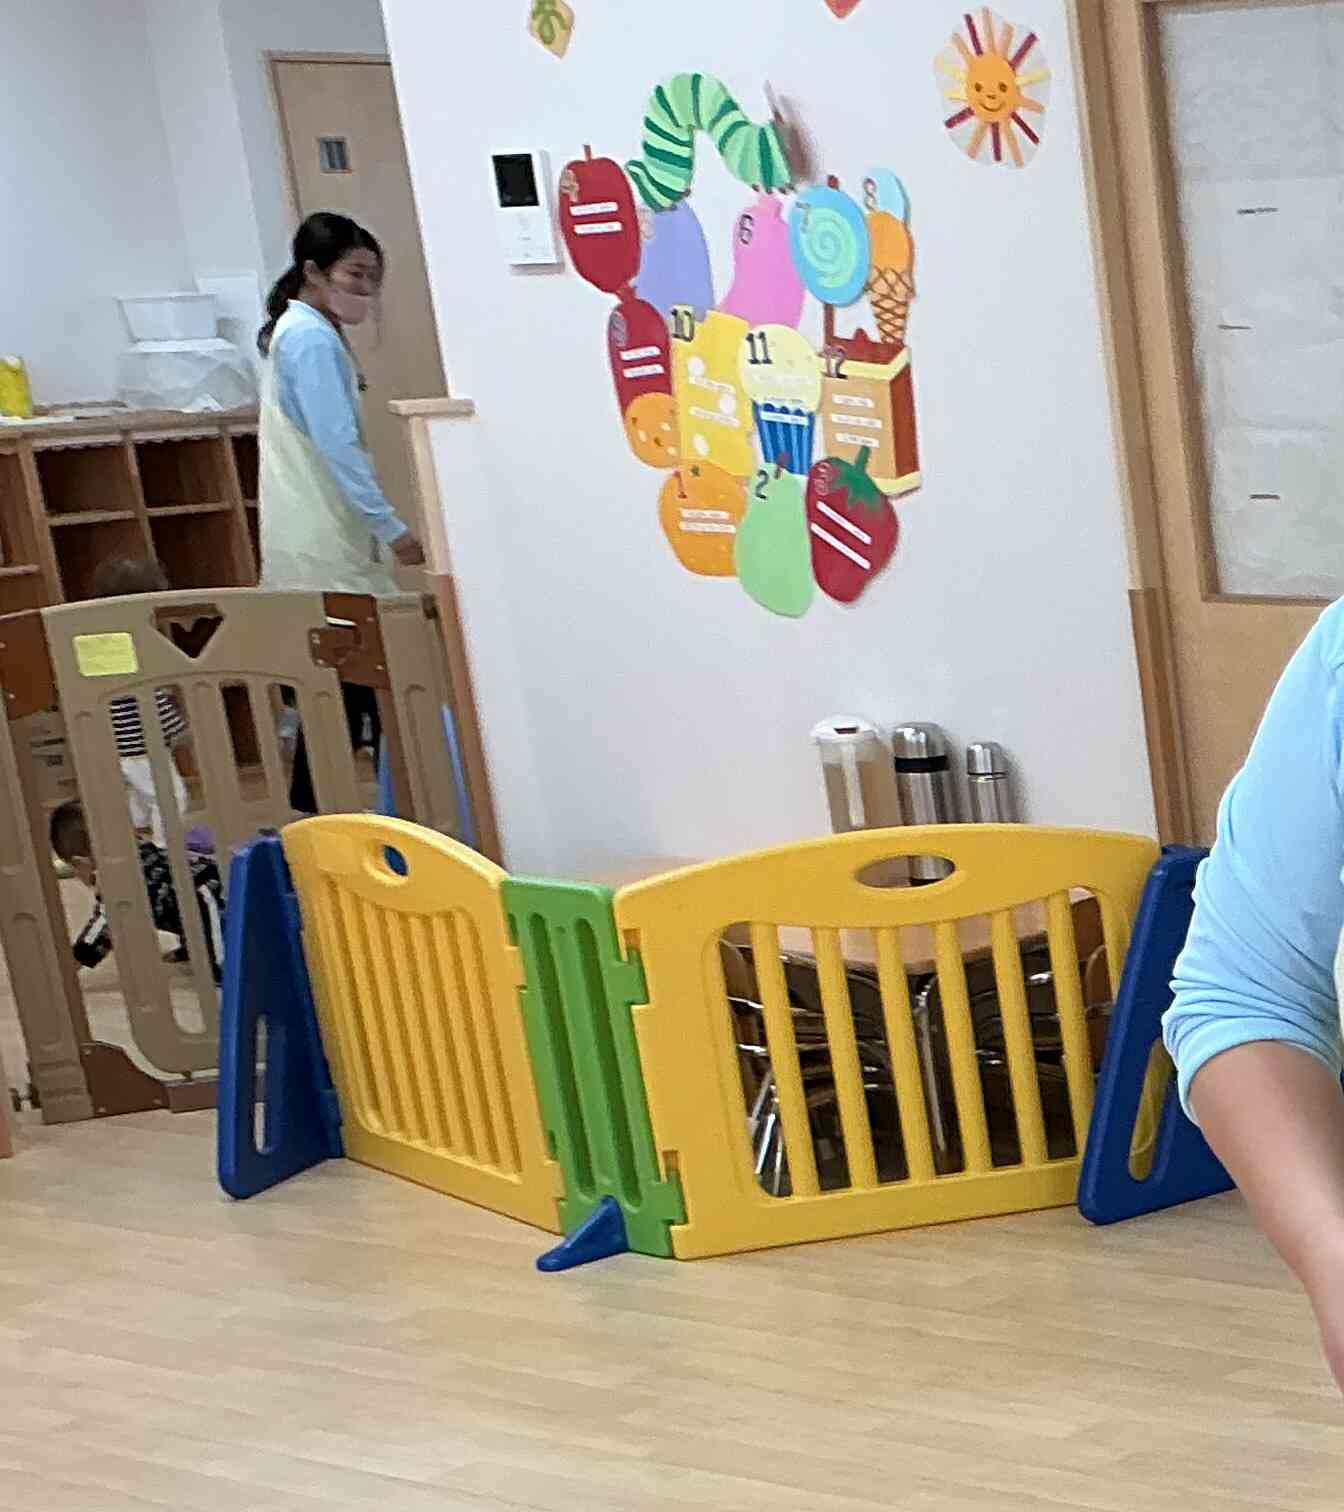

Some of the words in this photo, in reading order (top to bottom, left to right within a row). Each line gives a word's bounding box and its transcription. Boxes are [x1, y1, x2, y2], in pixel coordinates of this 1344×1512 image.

[739, 214, 753, 245] 6
[671, 309, 695, 342] 10
[746, 332, 772, 364] 11
[818, 344, 848, 379] 12
[672, 470, 687, 499] 1
[755, 470, 769, 501] 2
